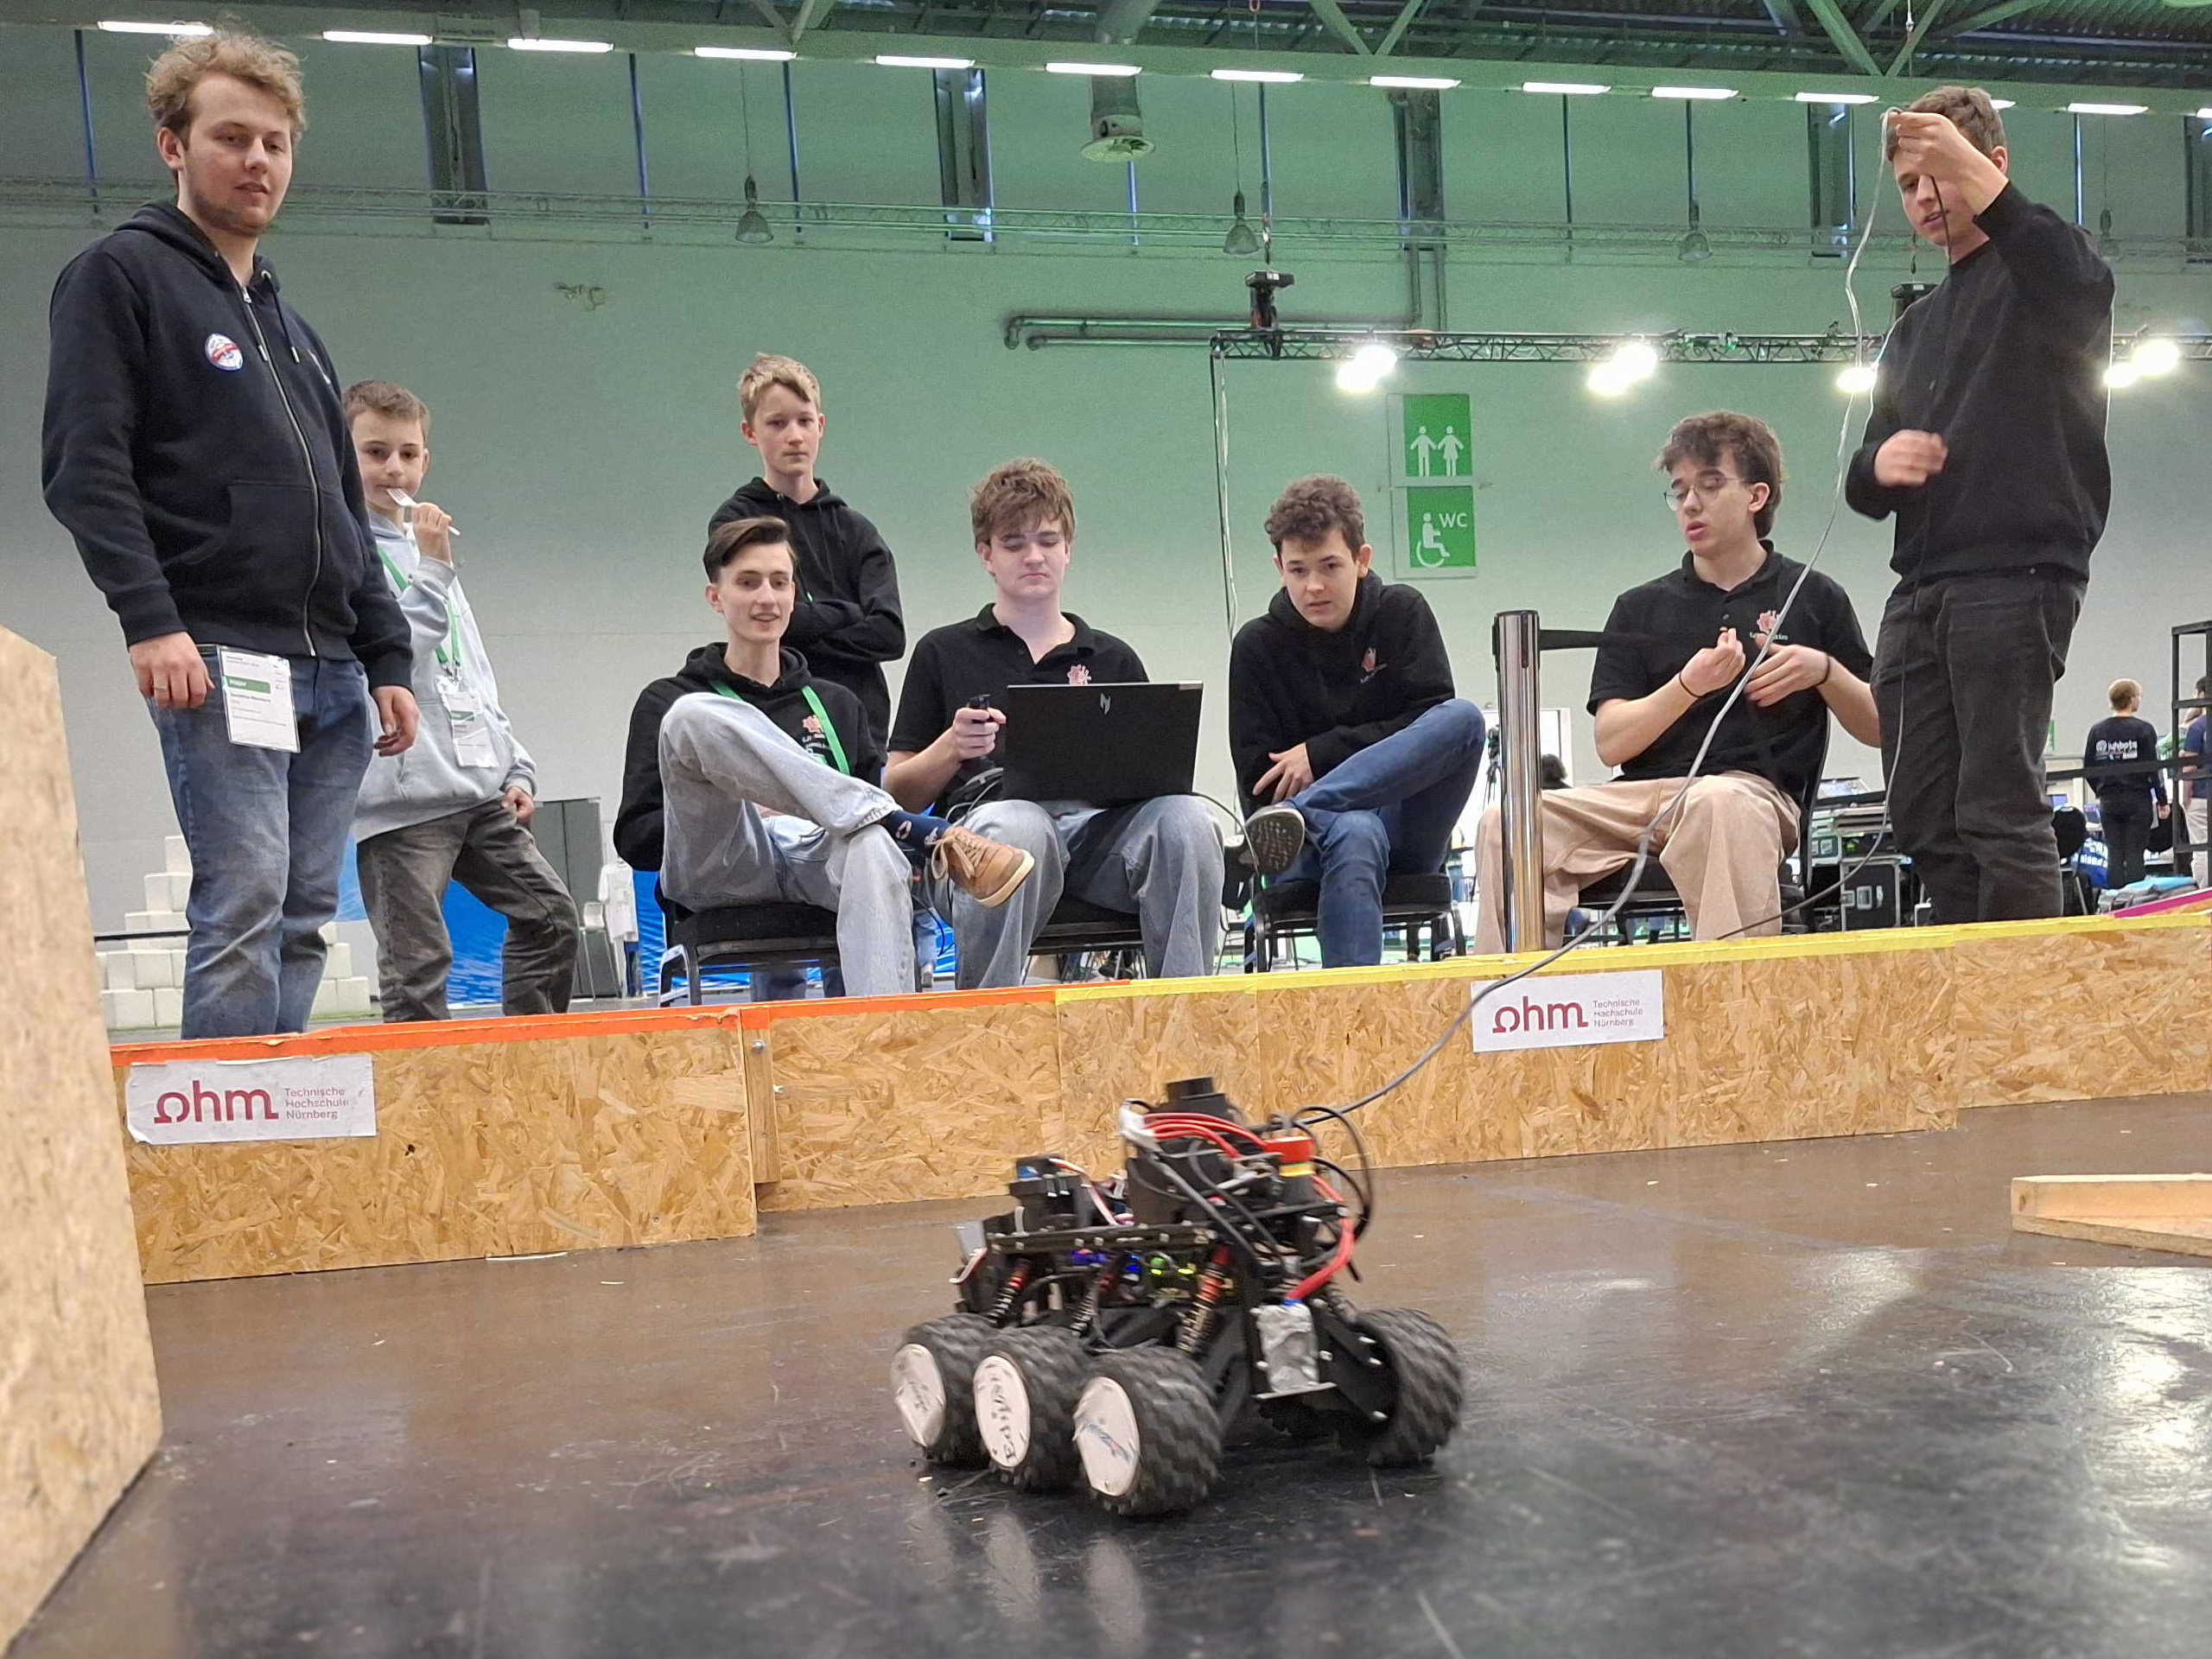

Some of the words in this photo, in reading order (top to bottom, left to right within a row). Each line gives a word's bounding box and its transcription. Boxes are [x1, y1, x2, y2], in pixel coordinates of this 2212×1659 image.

[1438, 512, 1467, 528] WC
[1592, 999, 1640, 1009] Technische
[1593, 1007, 1643, 1018] Hochschule
[1593, 1019, 1634, 1028] Nürnberg
[284, 1086, 346, 1097] Technische
[285, 1097, 349, 1108] Hochschule
[286, 1109, 338, 1121] Nürnberg
